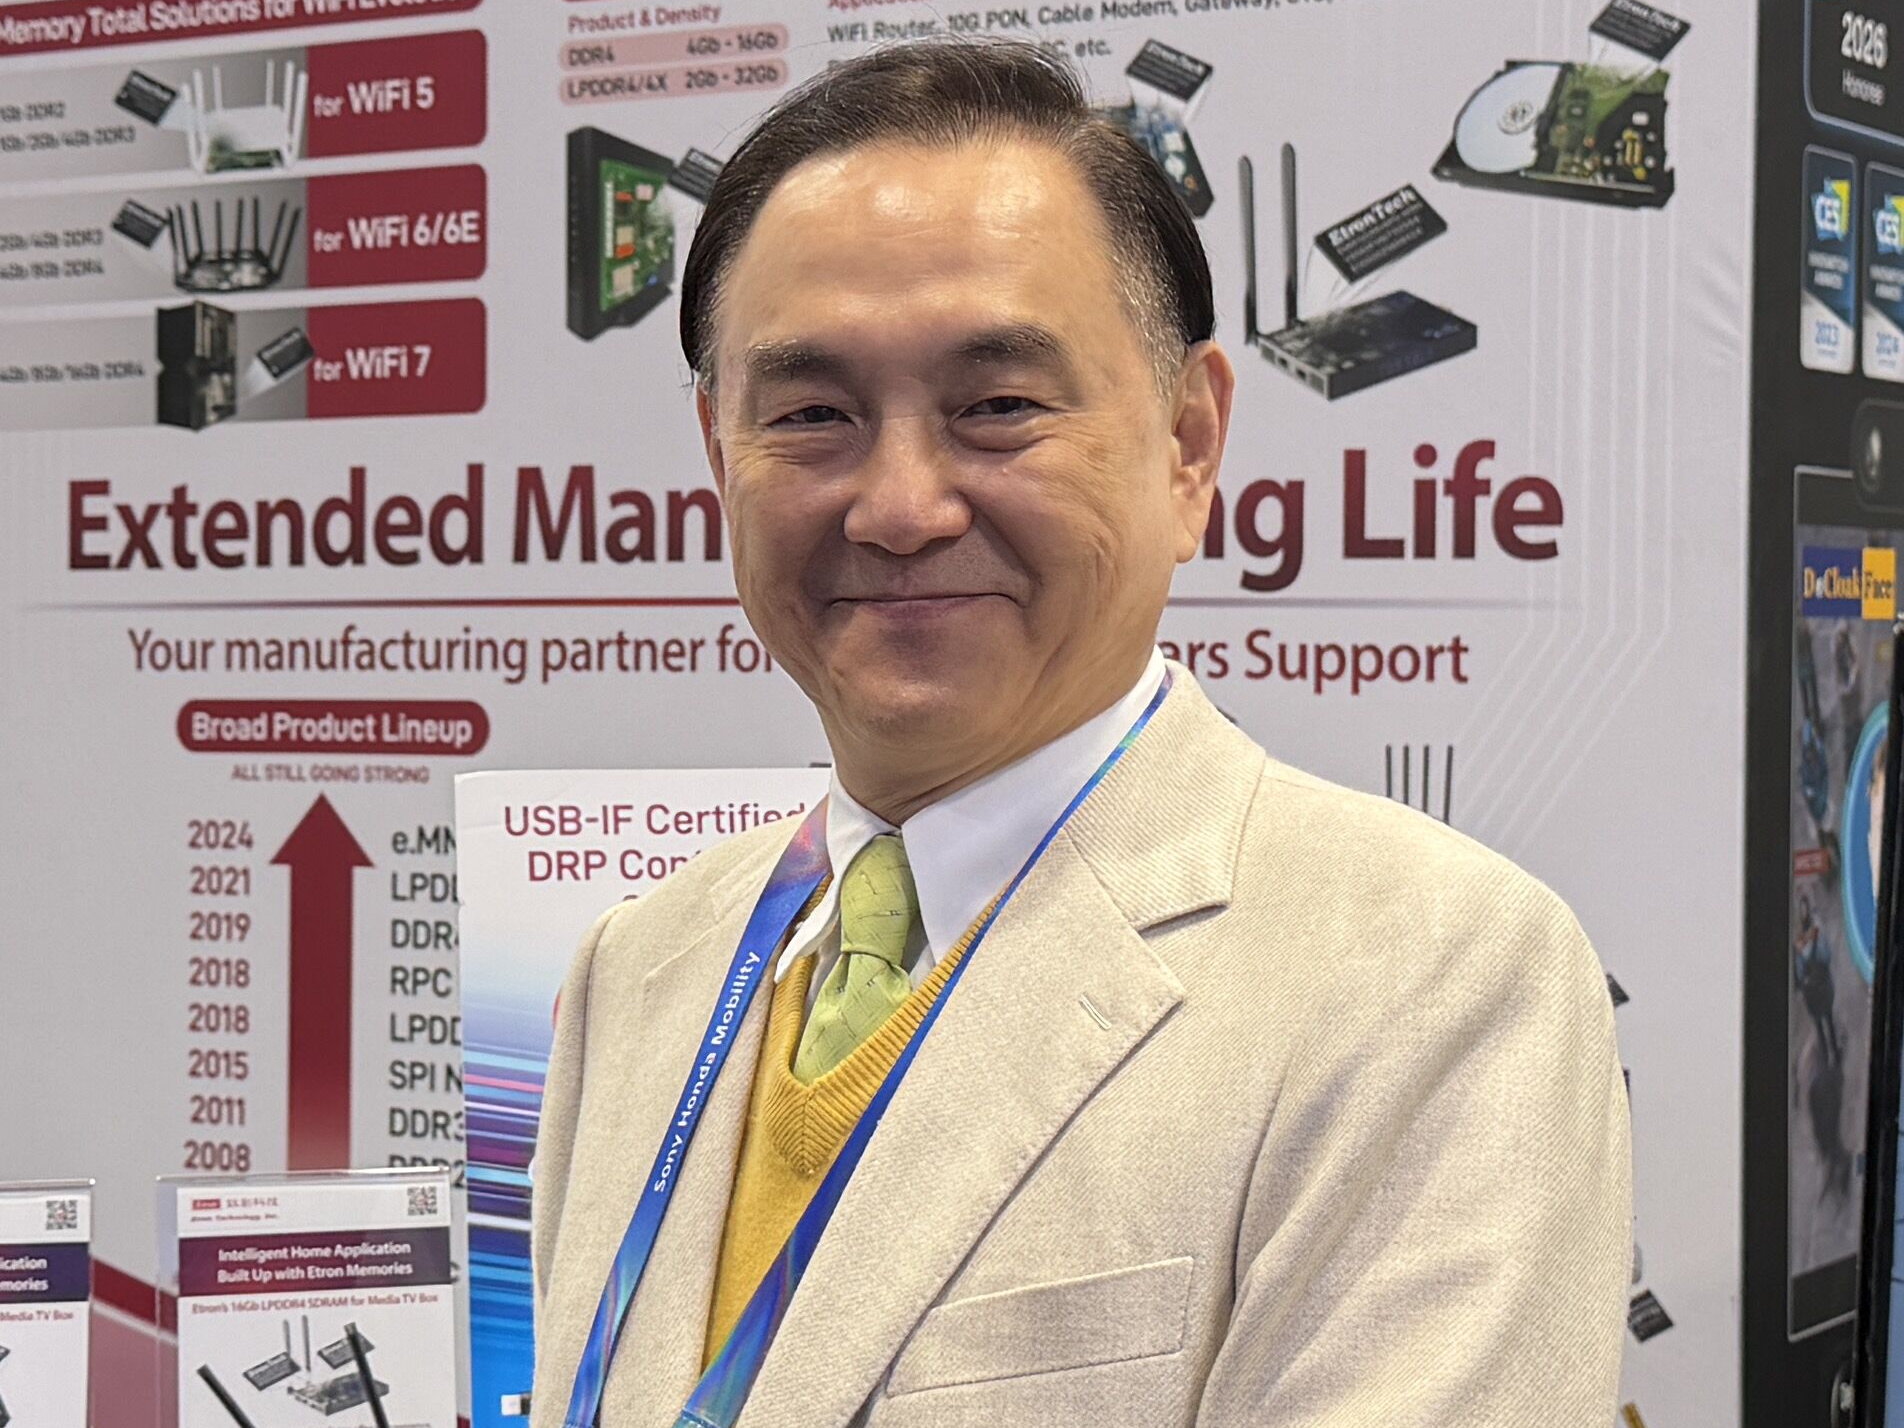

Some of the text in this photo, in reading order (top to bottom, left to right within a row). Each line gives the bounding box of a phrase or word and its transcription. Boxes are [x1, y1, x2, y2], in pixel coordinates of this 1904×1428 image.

[88, 3, 147, 36] Total
[567, 2, 722, 34] Product Density
[1038, 3, 1094, 25] Cable
[1840, 11, 1890, 70] 2026
[313, 78, 436, 118] for WiFi 5
[313, 211, 481, 252] for WiFi 6/6E
[313, 346, 432, 381] for WiFi 7
[68, 461, 486, 571] Extended
[1342, 439, 1565, 561] Life
[127, 623, 1469, 696] Your manufacturing partner Support
[192, 711, 473, 749] Broad Product Lineup
[187, 820, 254, 850] 2024
[505, 804, 635, 837] USB-IF
[190, 866, 251, 897] 2021
[527, 850, 607, 882] DRP
[189, 912, 251, 942] 2019
[188, 957, 251, 989] 2018
[390, 965, 452, 998] RPC
[187, 1003, 250, 1035] 2018
[187, 1049, 249, 1081] 2015
[388, 1060, 436, 1092] SPI
[654, 950, 762, 1194] Sony Honda Mobility
[189, 1095, 246, 1127] 2011
[183, 1140, 251, 1172] 2008
[218, 1241, 412, 1264] Intelligent Home Application
[216, 1261, 413, 1285] Built Up with Etron Memories
